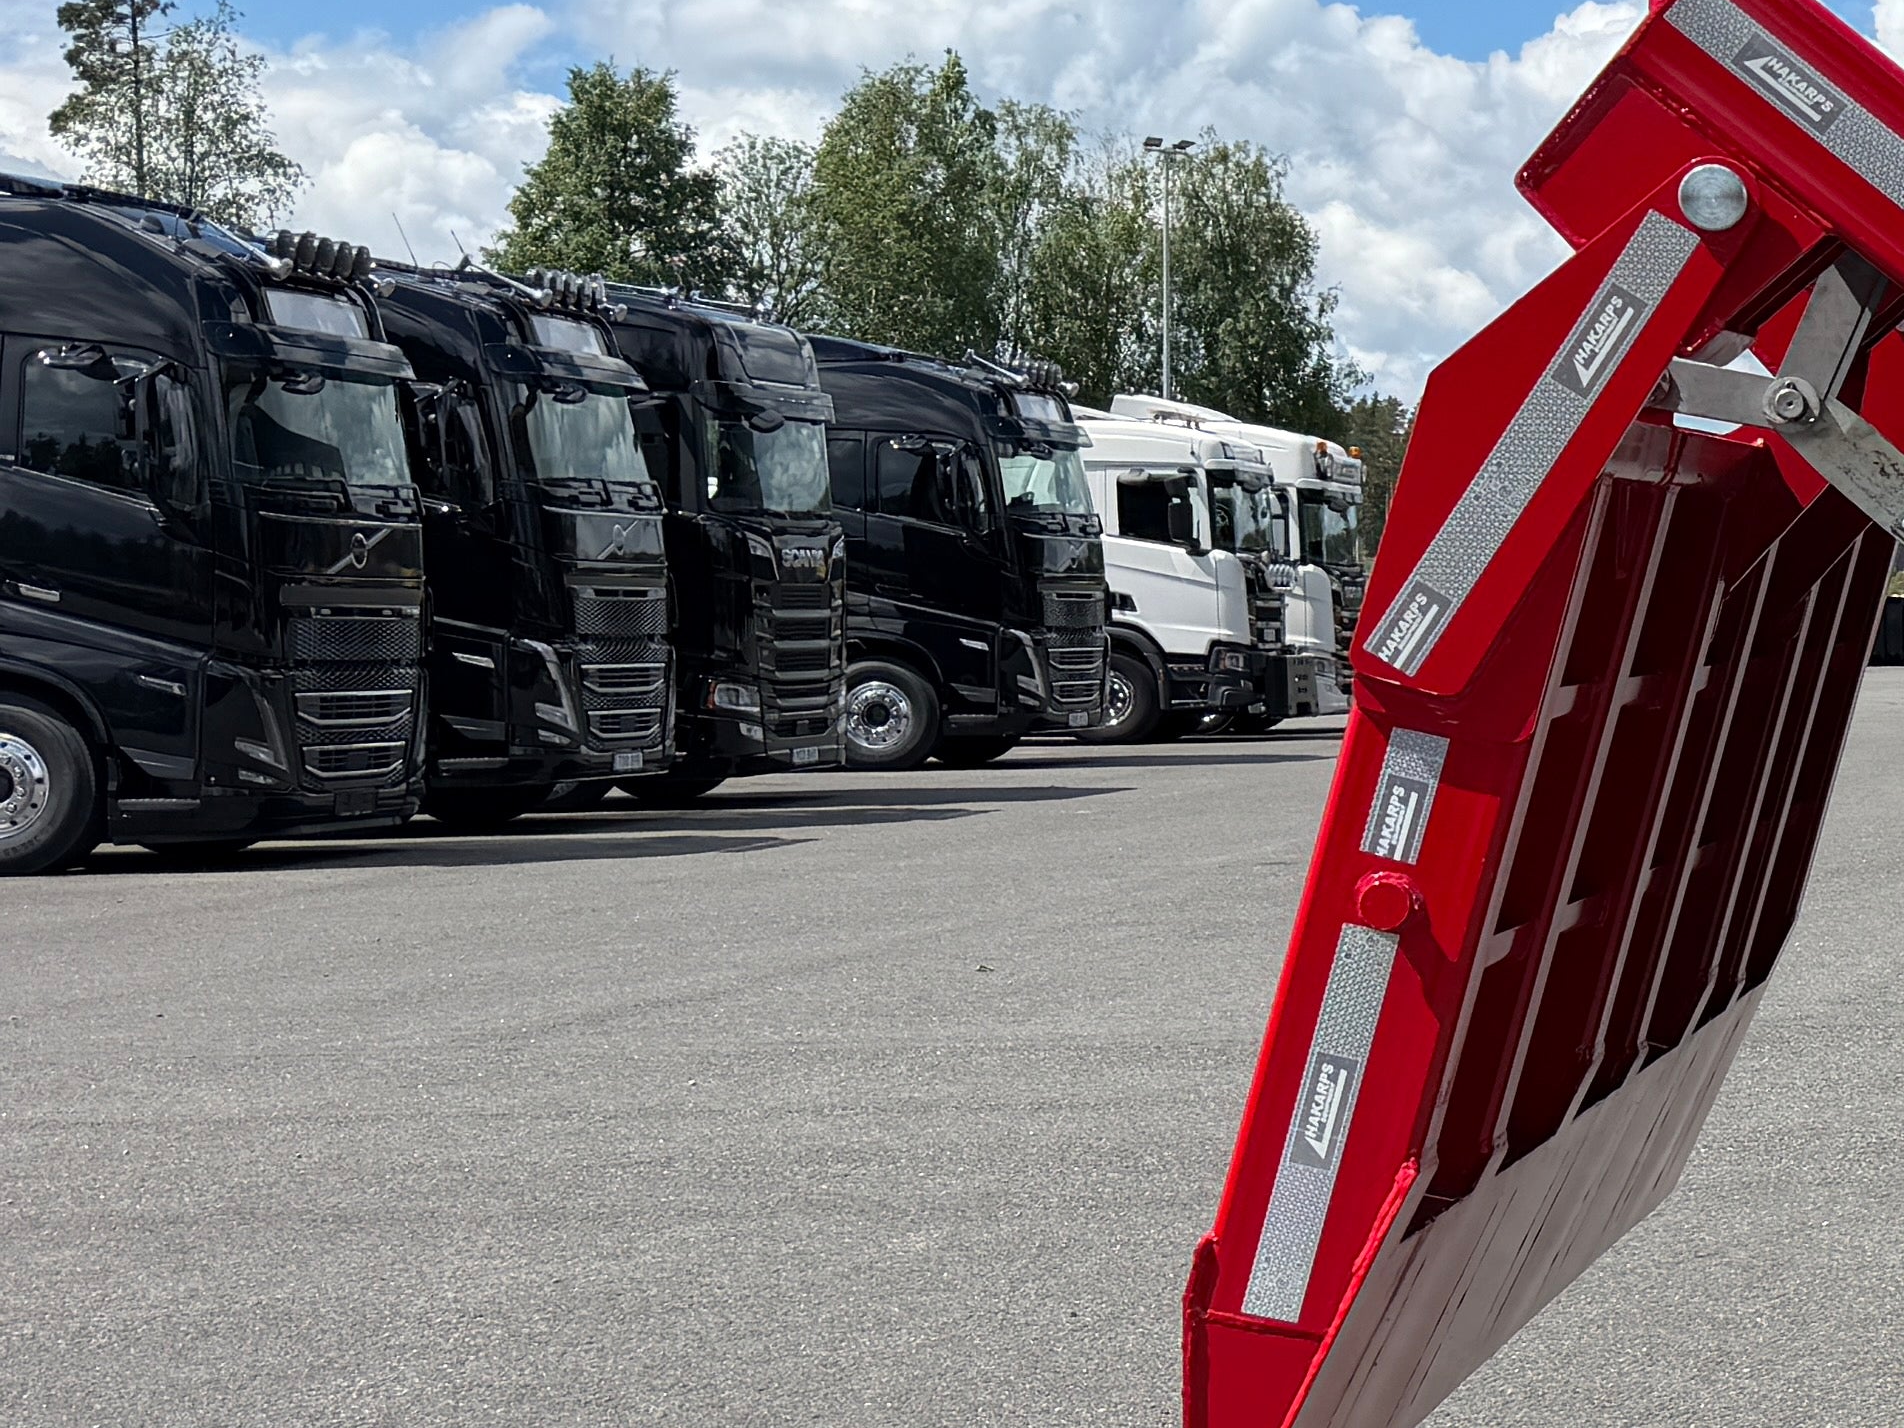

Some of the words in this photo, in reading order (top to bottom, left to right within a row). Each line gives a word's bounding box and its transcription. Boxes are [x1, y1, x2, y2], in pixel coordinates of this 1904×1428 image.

[1767, 57, 1834, 112] HAKARPS
[1574, 295, 1623, 364] HAKARPS
[1378, 592, 1427, 663] HAKARPS
[1305, 1062, 1334, 1138] HAKARPS
